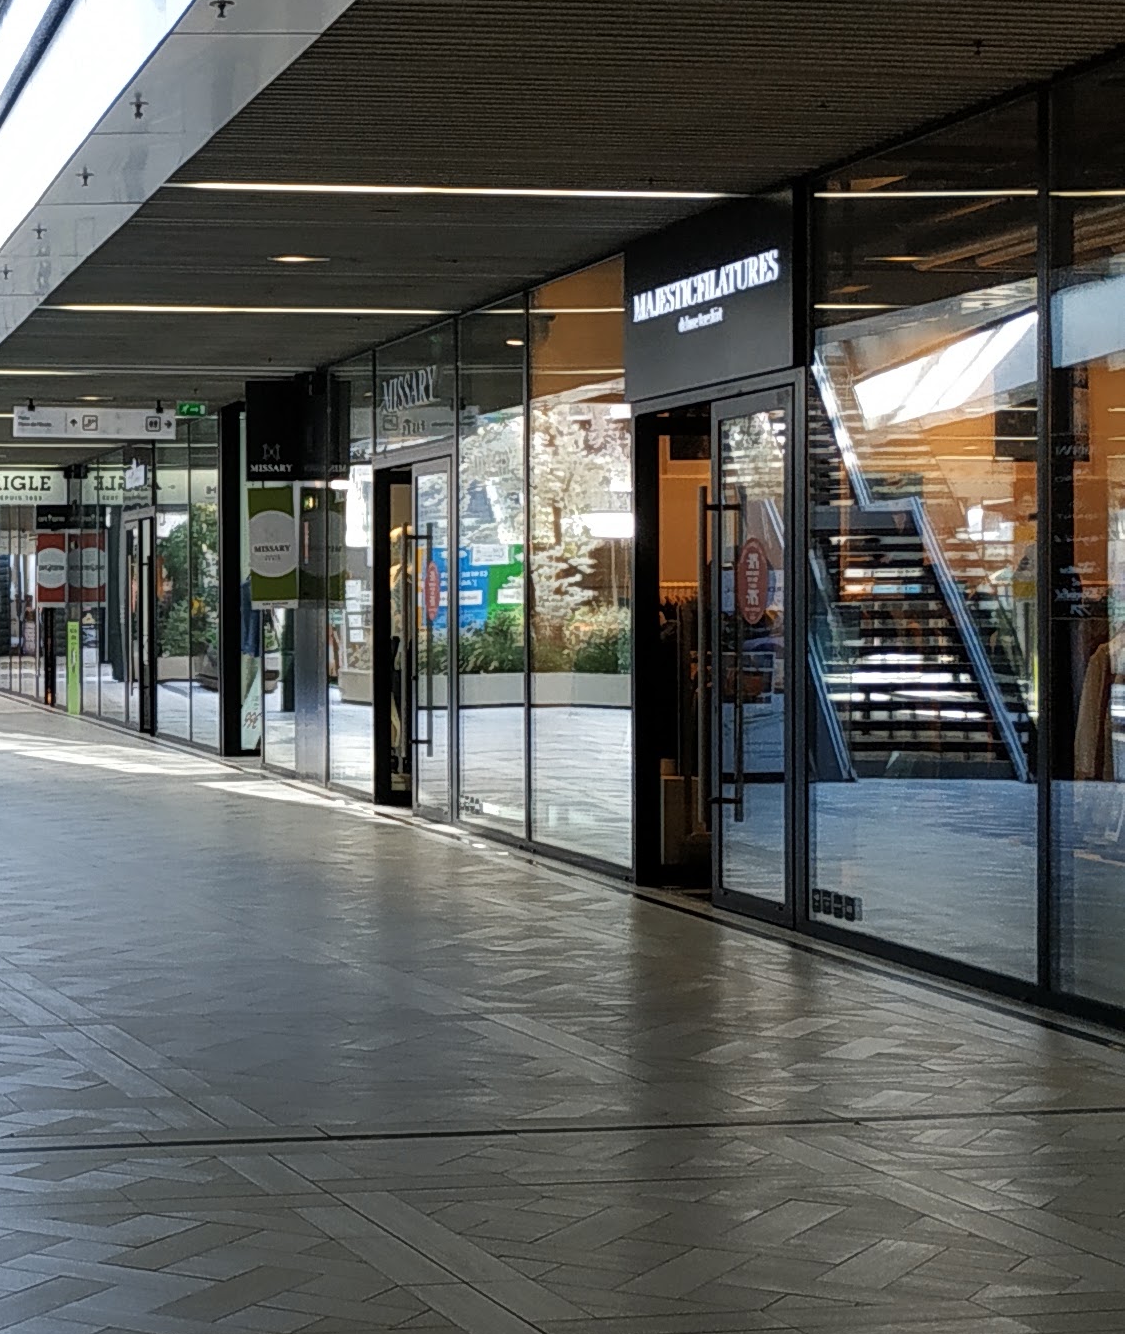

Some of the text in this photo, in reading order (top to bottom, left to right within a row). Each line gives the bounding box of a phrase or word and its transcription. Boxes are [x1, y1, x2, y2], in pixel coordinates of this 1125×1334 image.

[381, 366, 438, 413] MISSARY
[250, 463, 293, 473] MISSARY
[254, 544, 291, 554] MISSARY
